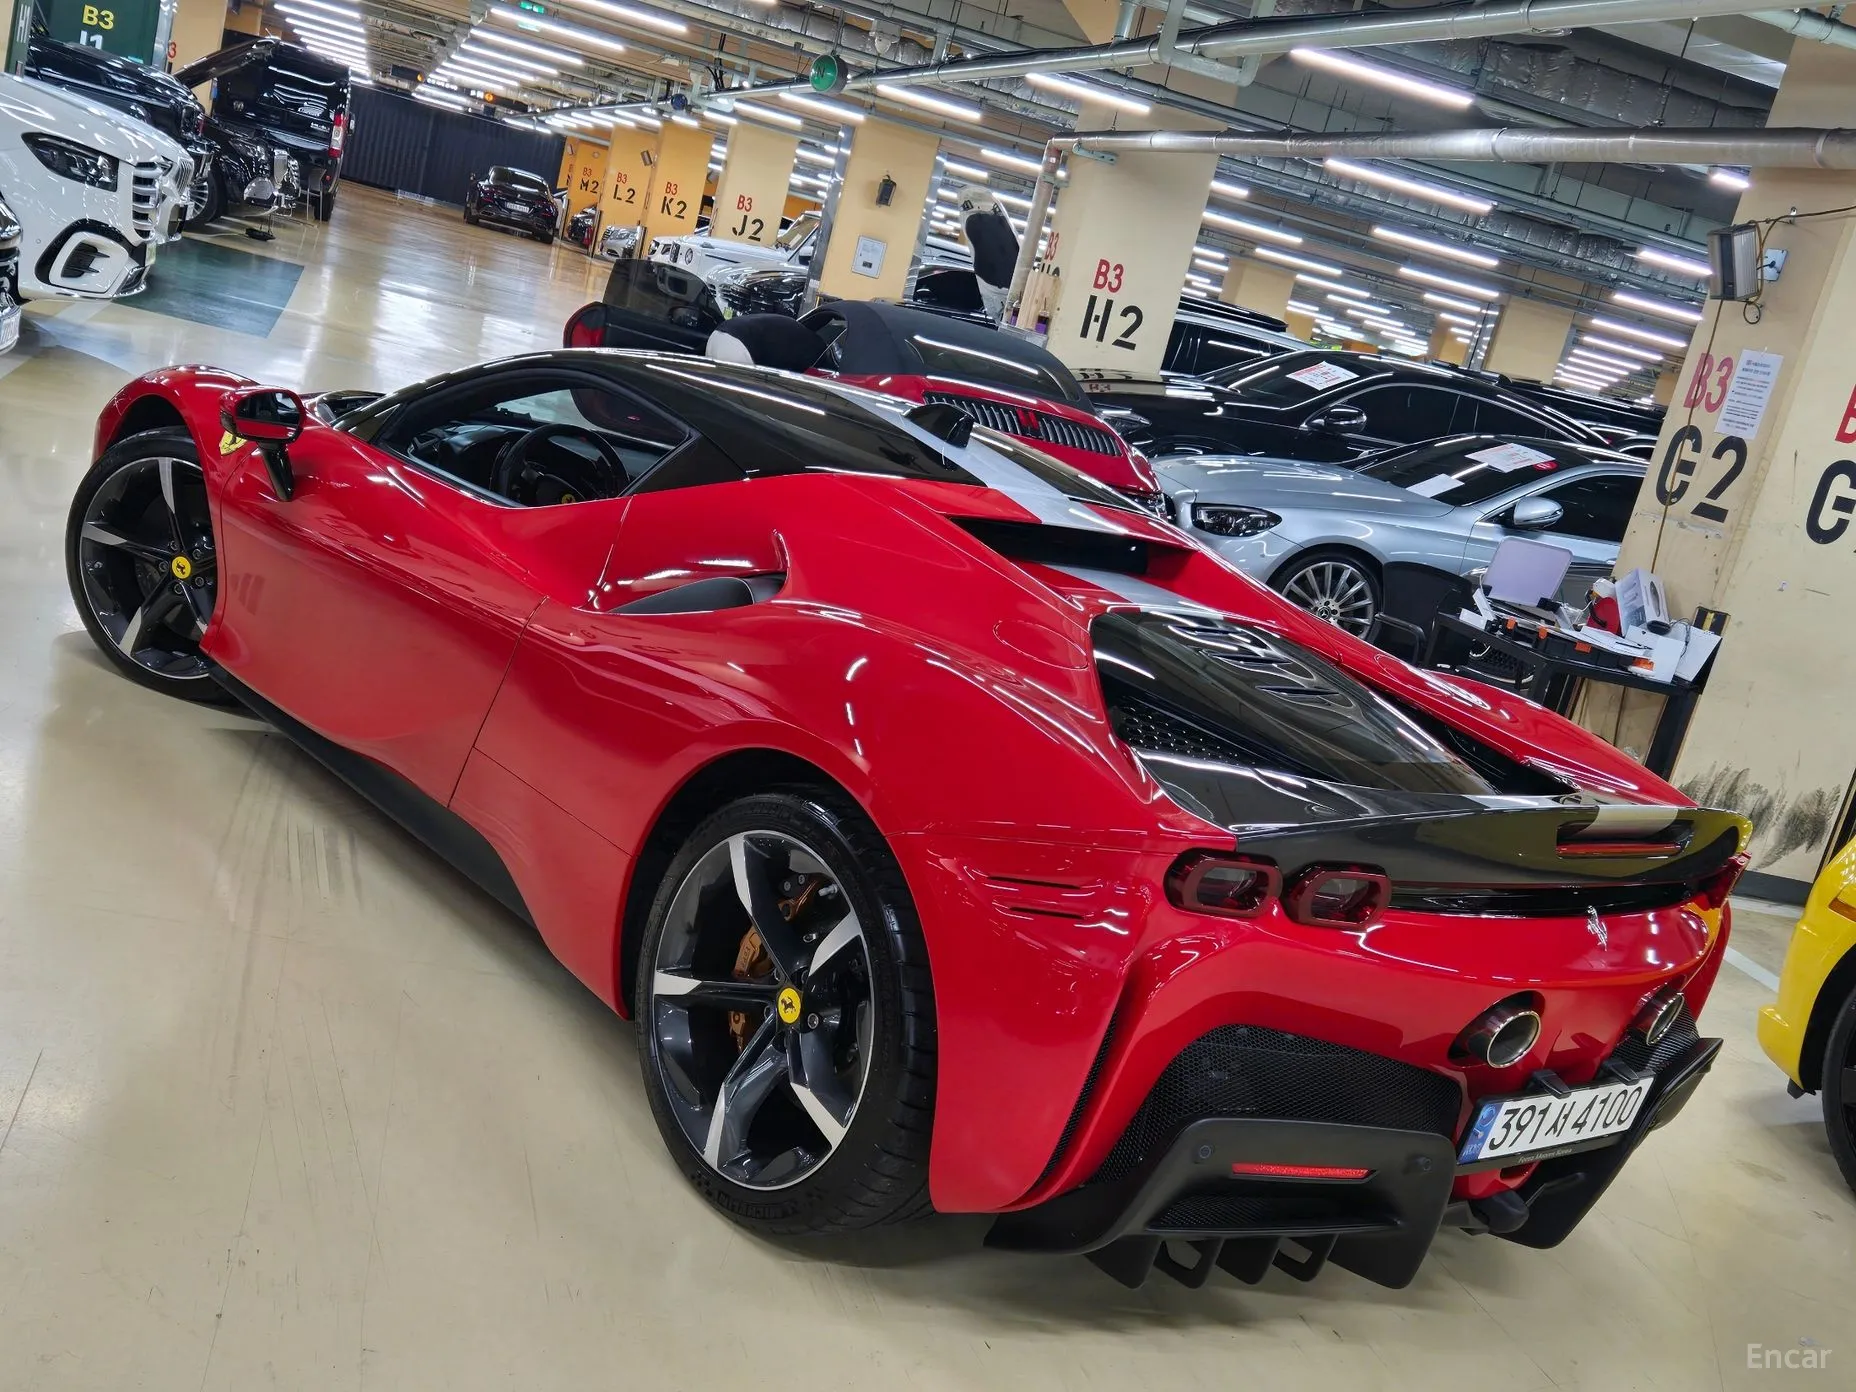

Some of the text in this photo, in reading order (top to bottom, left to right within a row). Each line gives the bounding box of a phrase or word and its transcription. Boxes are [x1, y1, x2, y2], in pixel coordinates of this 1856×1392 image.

[83, 4, 115, 30] B3
[582, 167, 593, 177] B3
[616, 172, 628, 185] B3
[579, 177, 600, 194] M2
[613, 184, 636, 204] L2
[665, 181, 679, 196] B3
[661, 195, 688, 219] K2
[736, 194, 753, 213] B3
[731, 214, 765, 242] J2
[1093, 258, 1124, 293] B3
[1079, 294, 1144, 351] H2
[1683, 352, 1734, 413] B3
[1656, 424, 1748, 524] G2
[1806, 459, 1856, 546] G
